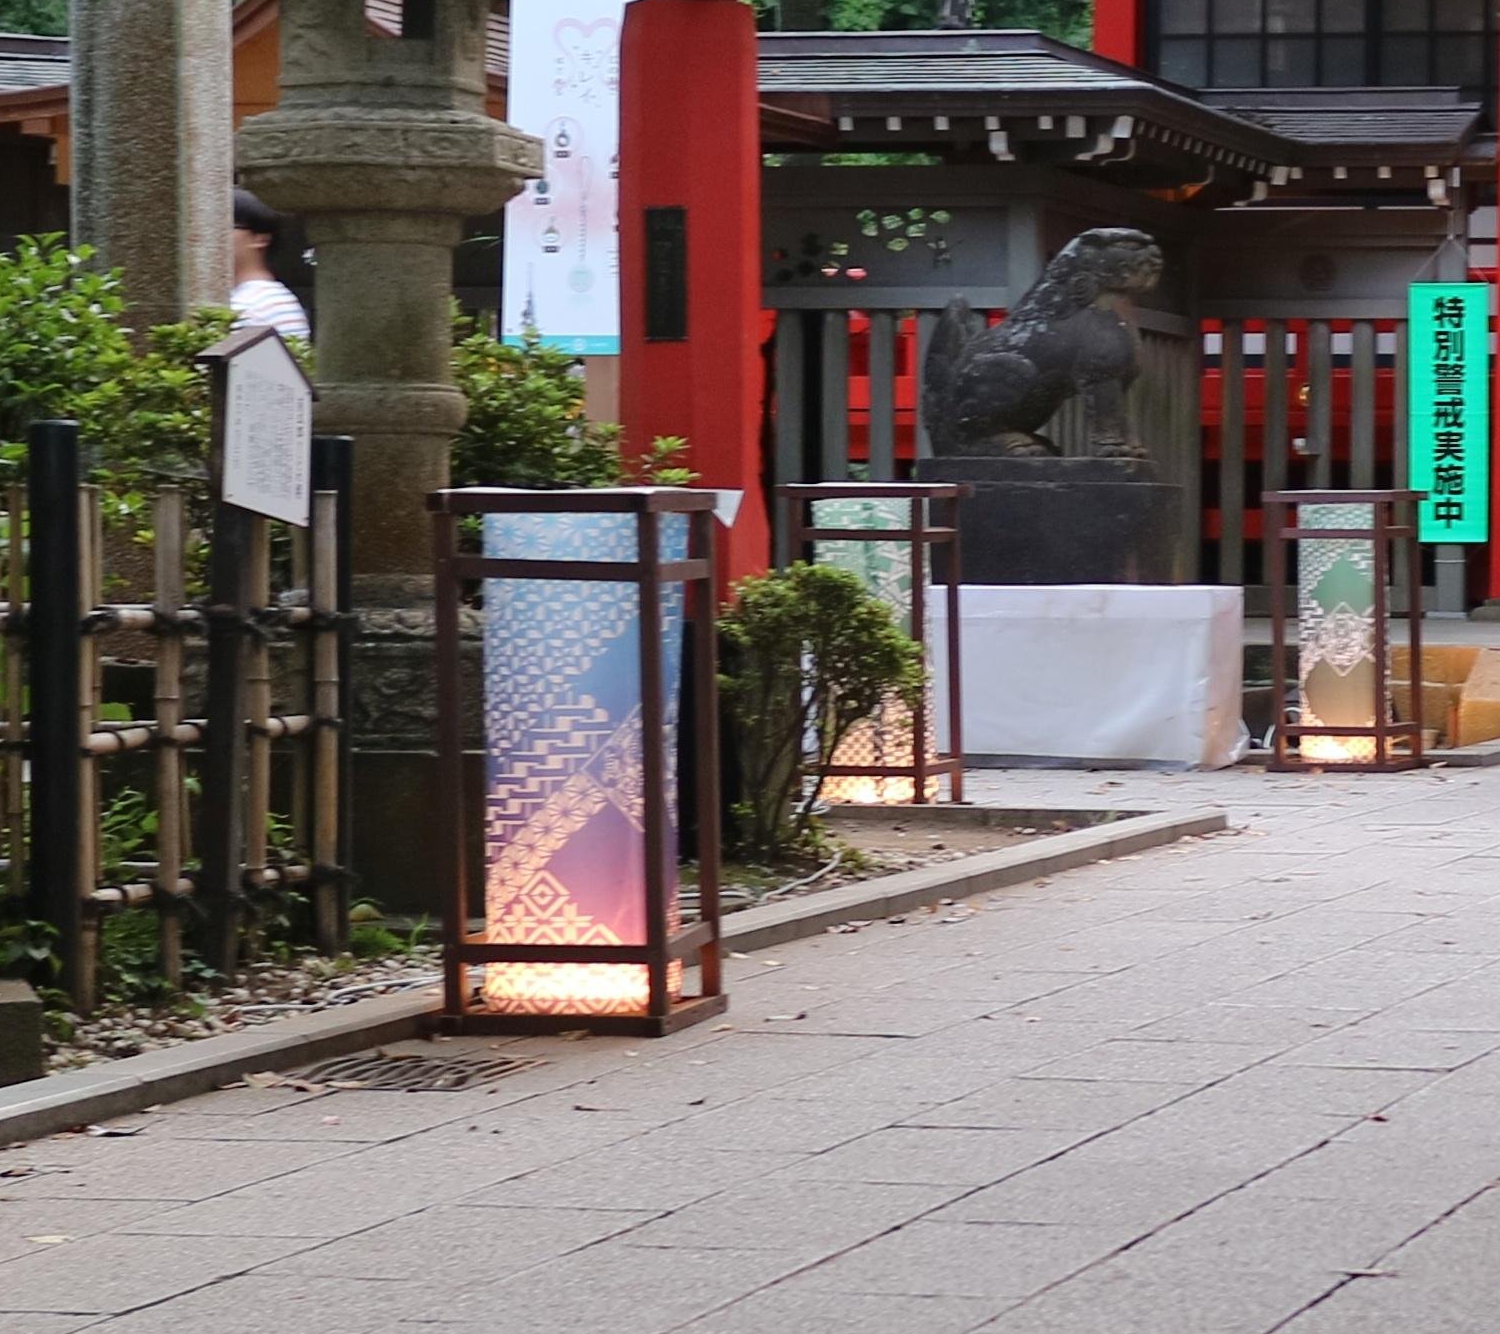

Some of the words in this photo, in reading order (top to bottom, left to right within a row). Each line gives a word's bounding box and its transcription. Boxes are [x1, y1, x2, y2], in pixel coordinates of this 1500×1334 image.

[1432, 296, 1466, 529] 特別警戒実施中
